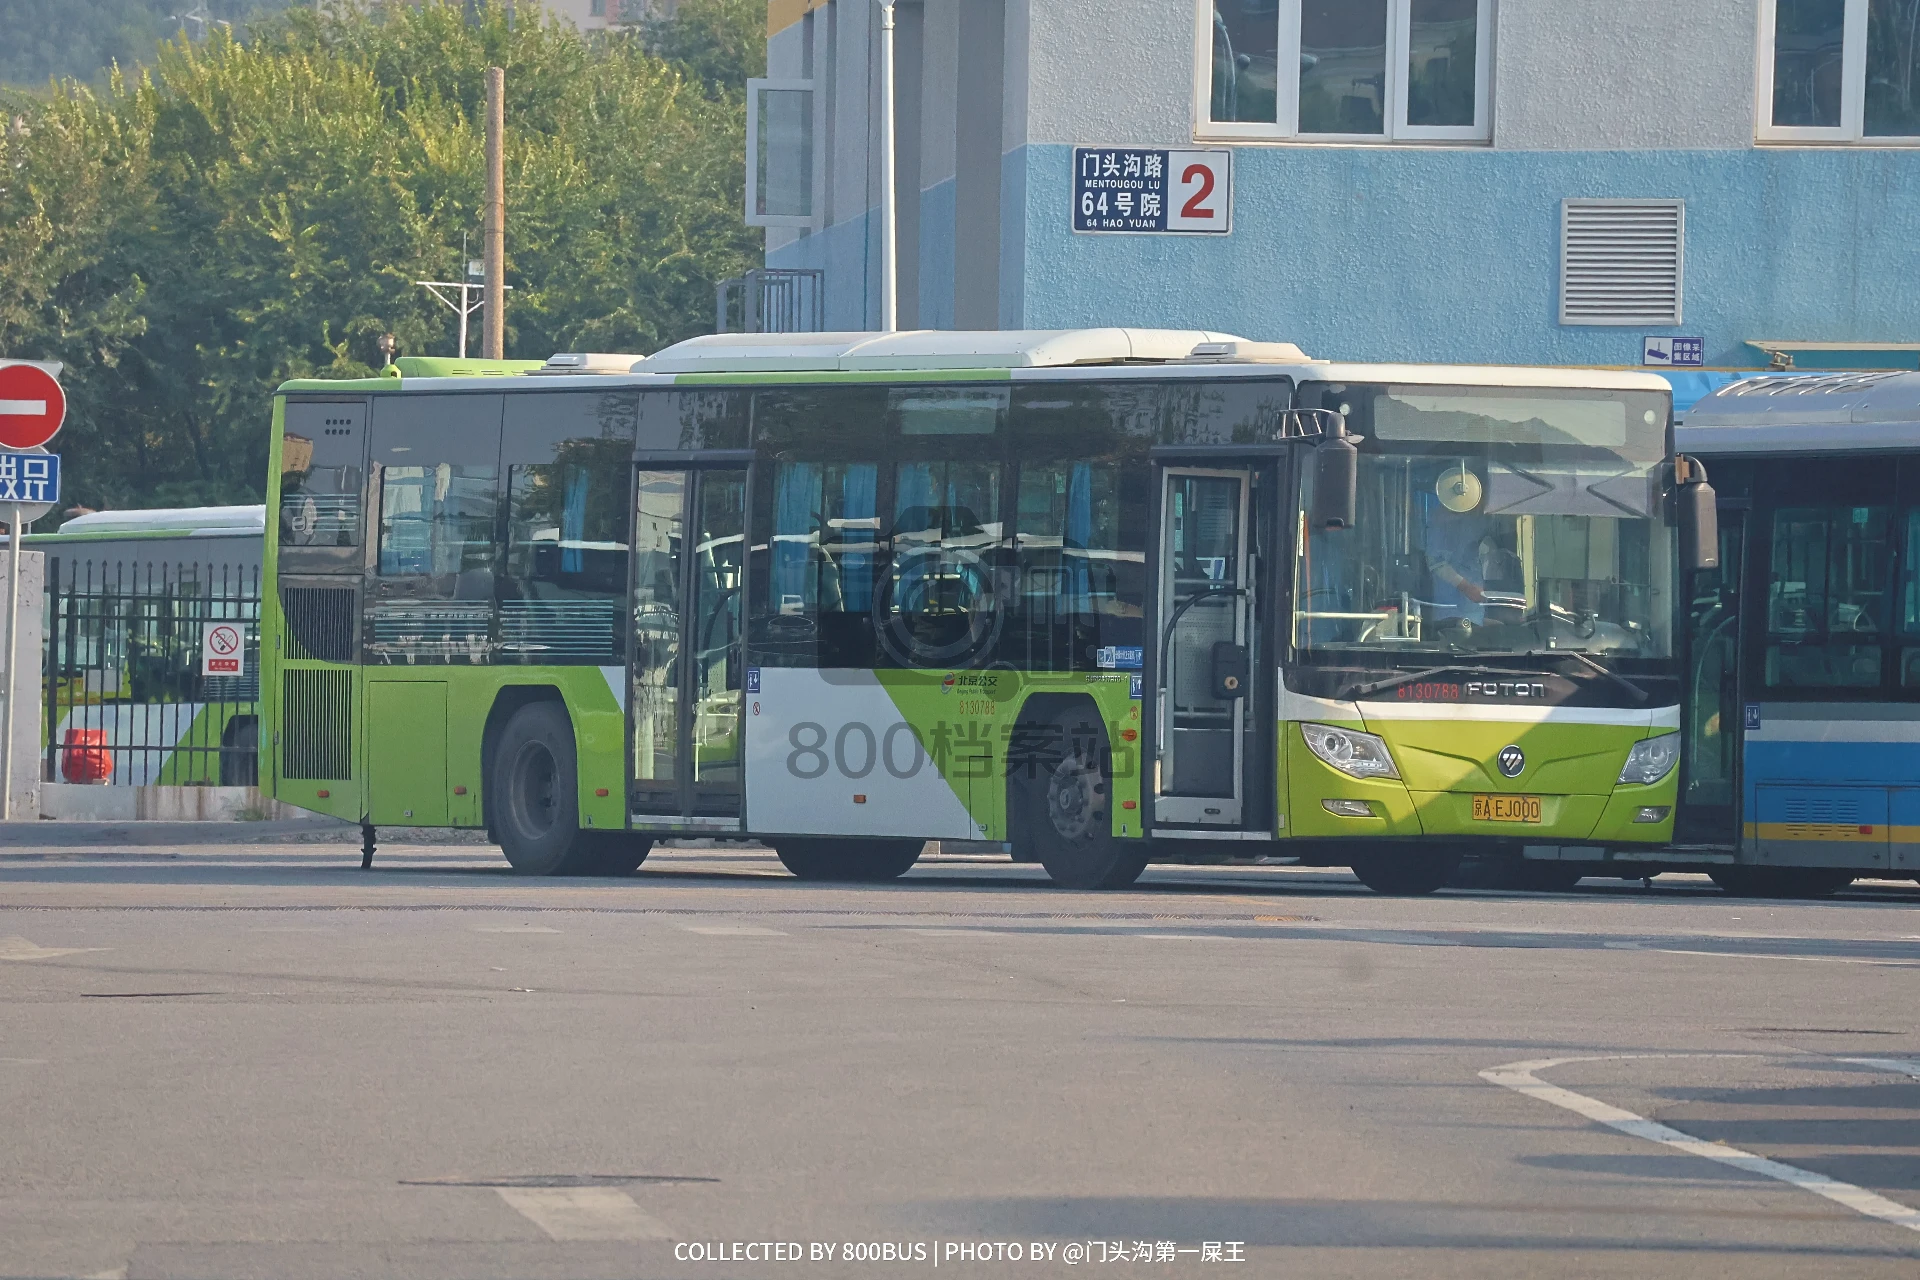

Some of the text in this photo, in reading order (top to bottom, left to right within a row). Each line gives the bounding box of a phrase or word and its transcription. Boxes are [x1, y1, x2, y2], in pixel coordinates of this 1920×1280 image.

[1082, 153, 1163, 178] 门头沟路
[1085, 179, 1160, 189] MENTOUGOU LU
[1180, 163, 1215, 218] 2
[1081, 191, 1161, 217] 64号院
[1086, 218, 1156, 228] 64 HAO YUAN
[0, 479, 49, 500] XIT
[958, 675, 998, 687] 北京公交
[1398, 683, 1459, 699] 8130788
[1467, 682, 1545, 697] FOTON
[959, 700, 995, 715] 8130788
